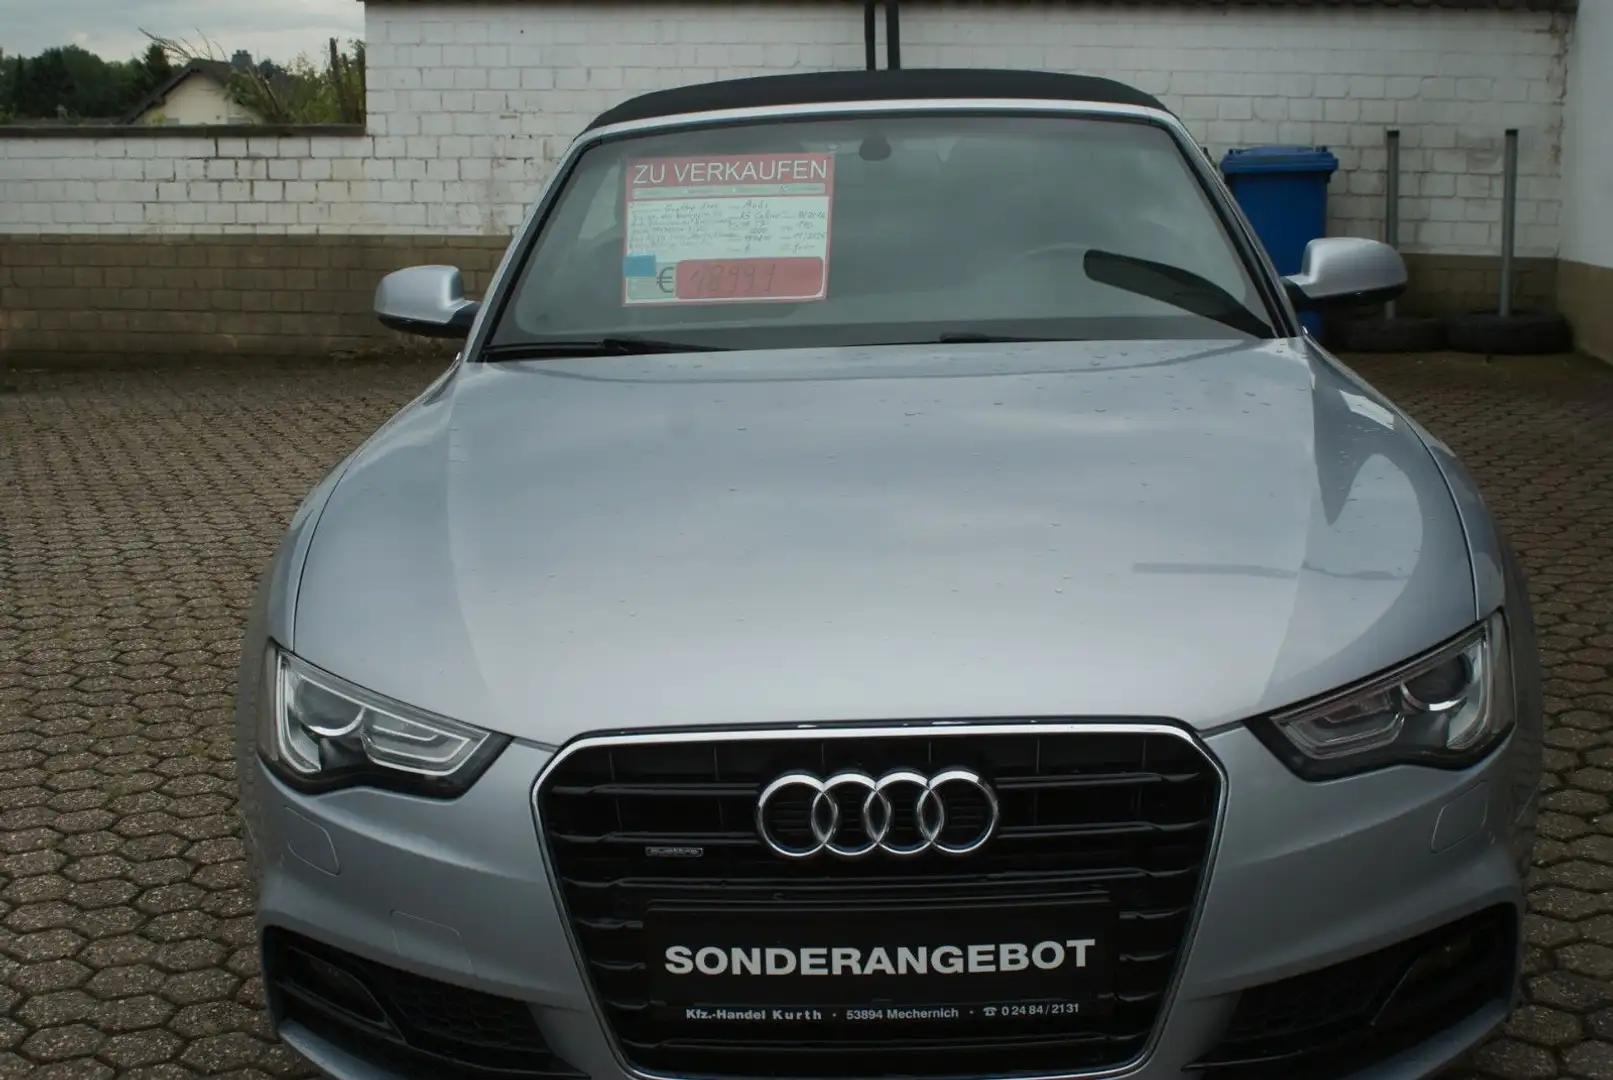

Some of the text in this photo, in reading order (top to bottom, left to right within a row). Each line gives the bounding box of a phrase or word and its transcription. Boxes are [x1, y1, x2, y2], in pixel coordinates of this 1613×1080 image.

[632, 159, 828, 184] ZU VERKAUFEN
[664, 938, 1096, 975] SONDERANGEBOT
[686, 1008, 766, 1020] Kfz.-Handel
[772, 1008, 822, 1020] Kurth
[846, 1008, 883, 1020] 53894
[886, 1007, 959, 1019] Mechernich
